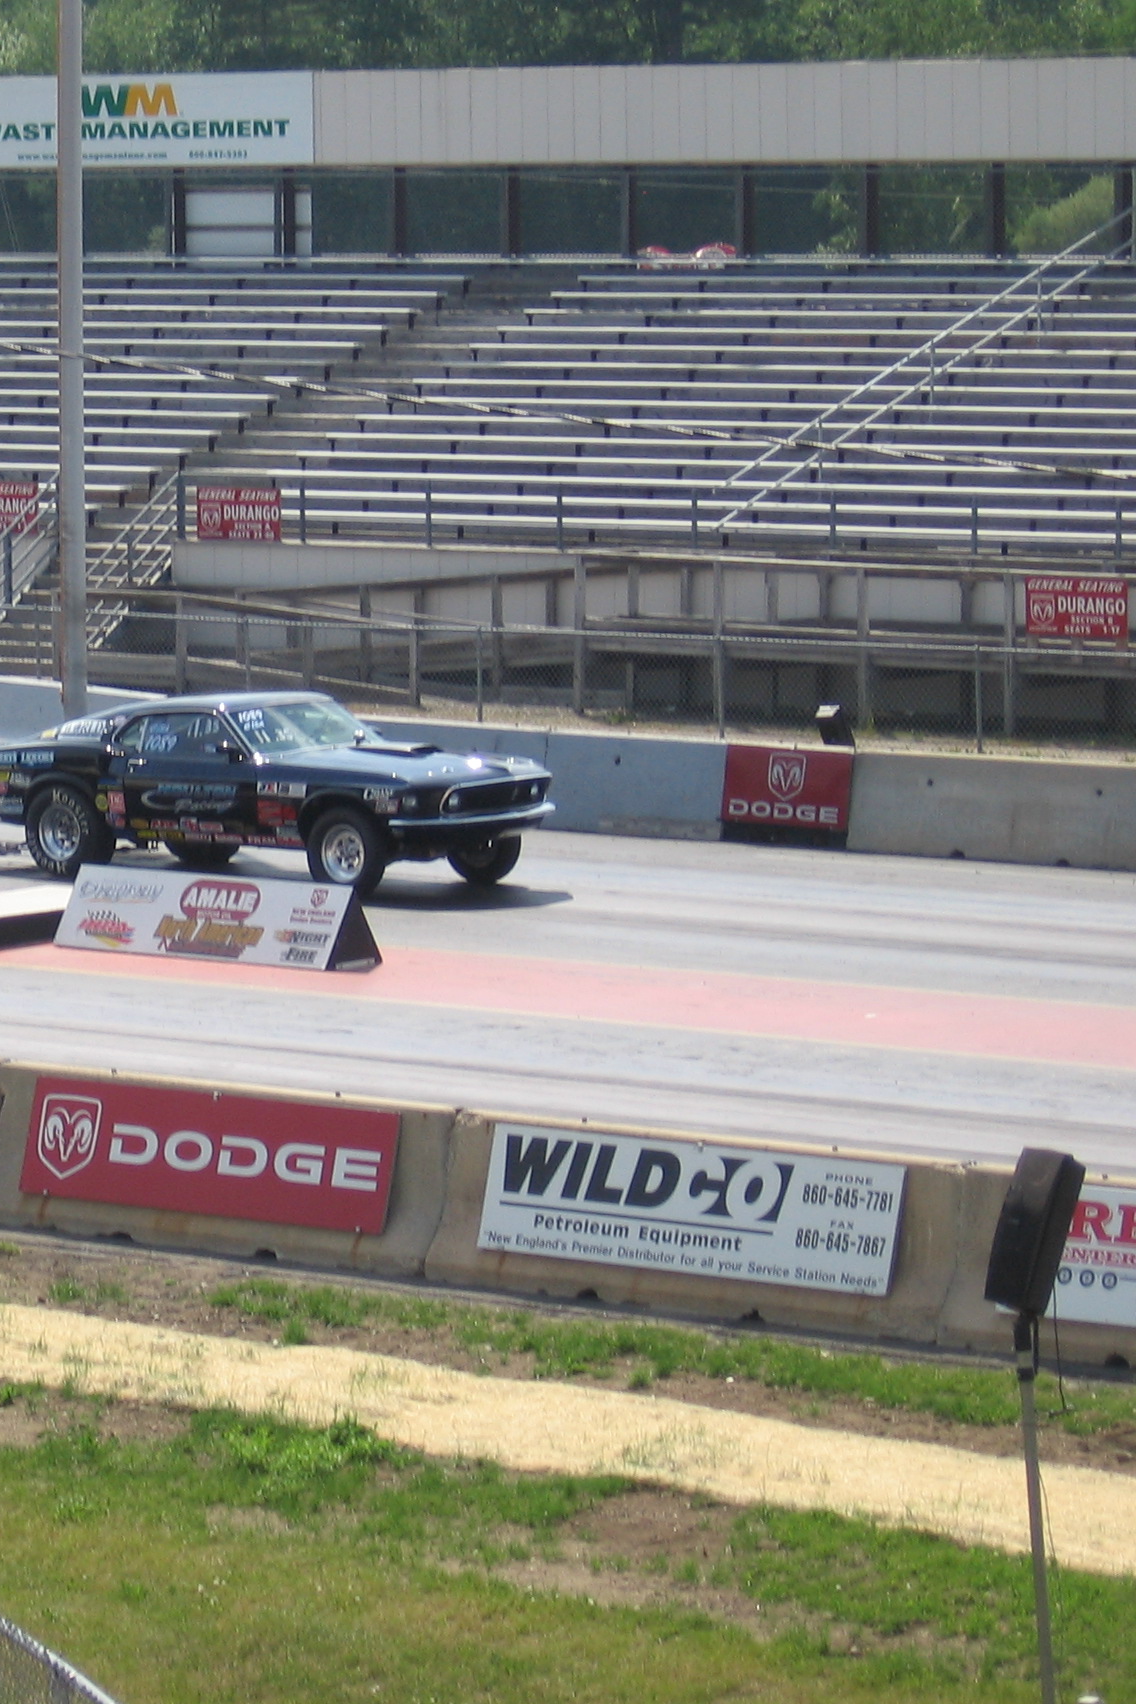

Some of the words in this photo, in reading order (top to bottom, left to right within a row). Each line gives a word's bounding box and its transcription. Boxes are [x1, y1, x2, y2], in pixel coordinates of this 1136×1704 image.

[81, 119, 290, 140] MANAGEMENT
[223, 504, 279, 522] DURANGO
[1027, 578, 1073, 592] GENERAL
[1077, 579, 1124, 593] SEATING
[1057, 595, 1126, 616] DURANGO
[1065, 625, 1091, 634] SEATS
[1071, 615, 1105, 625] SECTION
[728, 799, 839, 824] DODGE
[183, 886, 259, 913] AMALIE
[108, 1122, 382, 1192] DODGE
[503, 1133, 795, 1224] WILDCO
[825, 1172, 874, 1187] PHONE
[802, 1183, 894, 1214] 860-645-7781
[533, 1214, 630, 1239] Petroleum
[638, 1225, 743, 1252] Equipment
[830, 1219, 855, 1231] FAX
[795, 1228, 887, 1258] 860-645-7867
[515, 1233, 568, 1251] England's
[571, 1241, 613, 1257] Premier
[617, 1247, 676, 1265] Distributor
[680, 1253, 697, 1266] for
[700, 1255, 715, 1268] all
[718, 1260, 743, 1273] your
[747, 1262, 790, 1278] Service
[794, 1267, 837, 1283] Station
